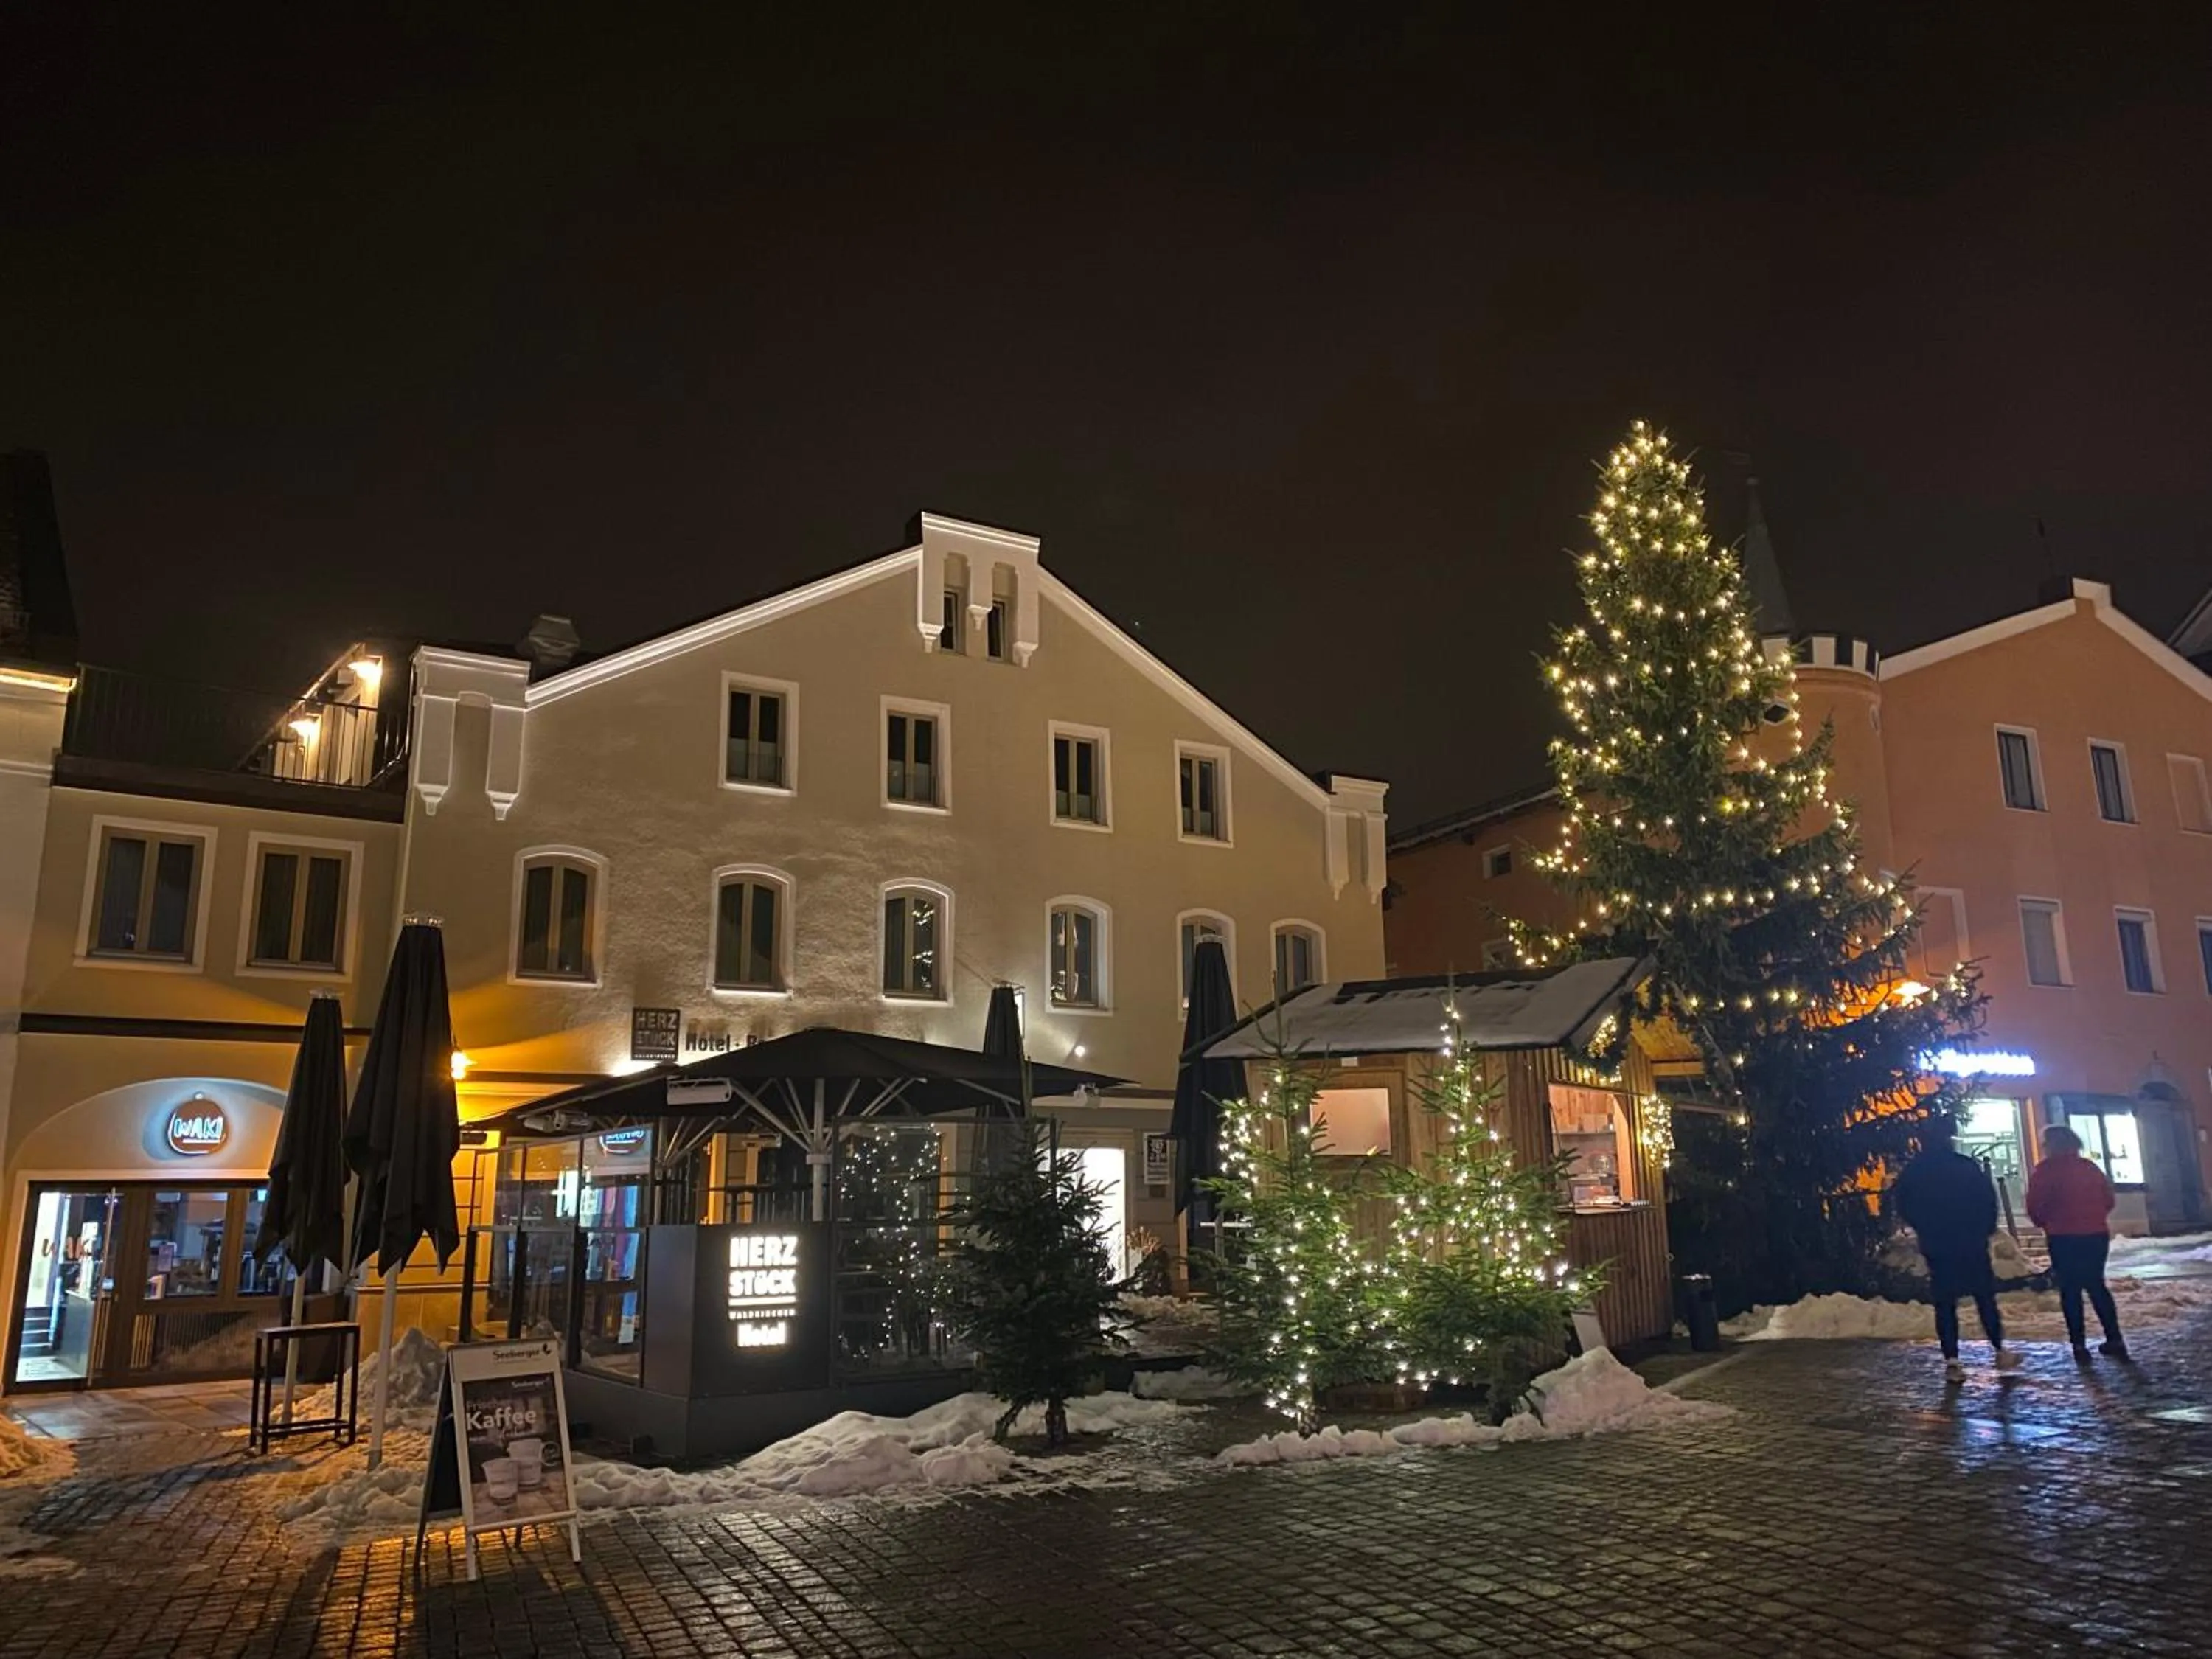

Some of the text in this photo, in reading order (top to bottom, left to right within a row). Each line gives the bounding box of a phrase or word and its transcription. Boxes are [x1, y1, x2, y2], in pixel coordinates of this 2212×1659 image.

[636, 1012, 677, 1029] HERZ
[686, 1034, 731, 1051] Hotel
[730, 1237, 797, 1267] HERZ
[466, 1407, 537, 1430] Kaffee
